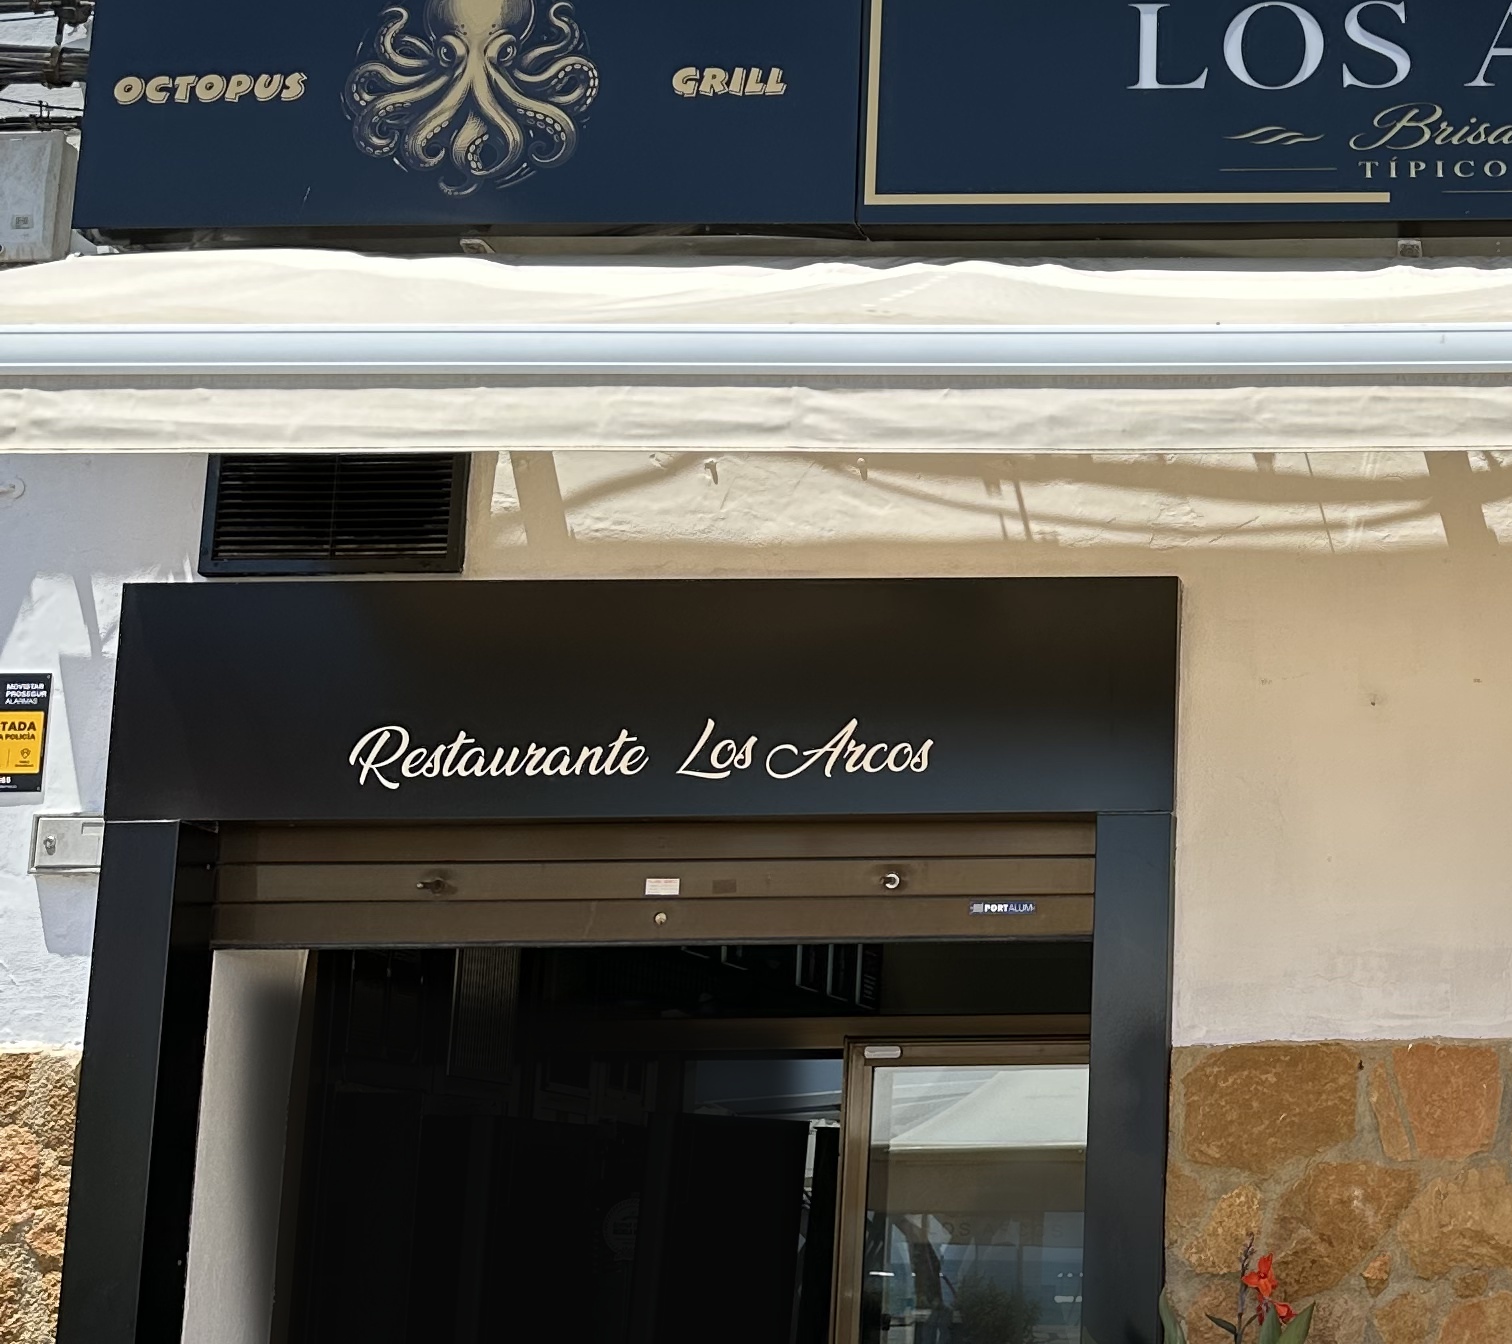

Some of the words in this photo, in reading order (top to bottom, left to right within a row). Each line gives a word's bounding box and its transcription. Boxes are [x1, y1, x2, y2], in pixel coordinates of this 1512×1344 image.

[1127, 0, 1411, 90] LOS
[112, 71, 308, 105] OCTOPUS
[672, 66, 788, 98] GRILL
[1358, 156, 1507, 179] TÍPICO
[348, 725, 650, 790] Restaurante
[675, 718, 758, 780] Los
[765, 717, 934, 779] Arcos
